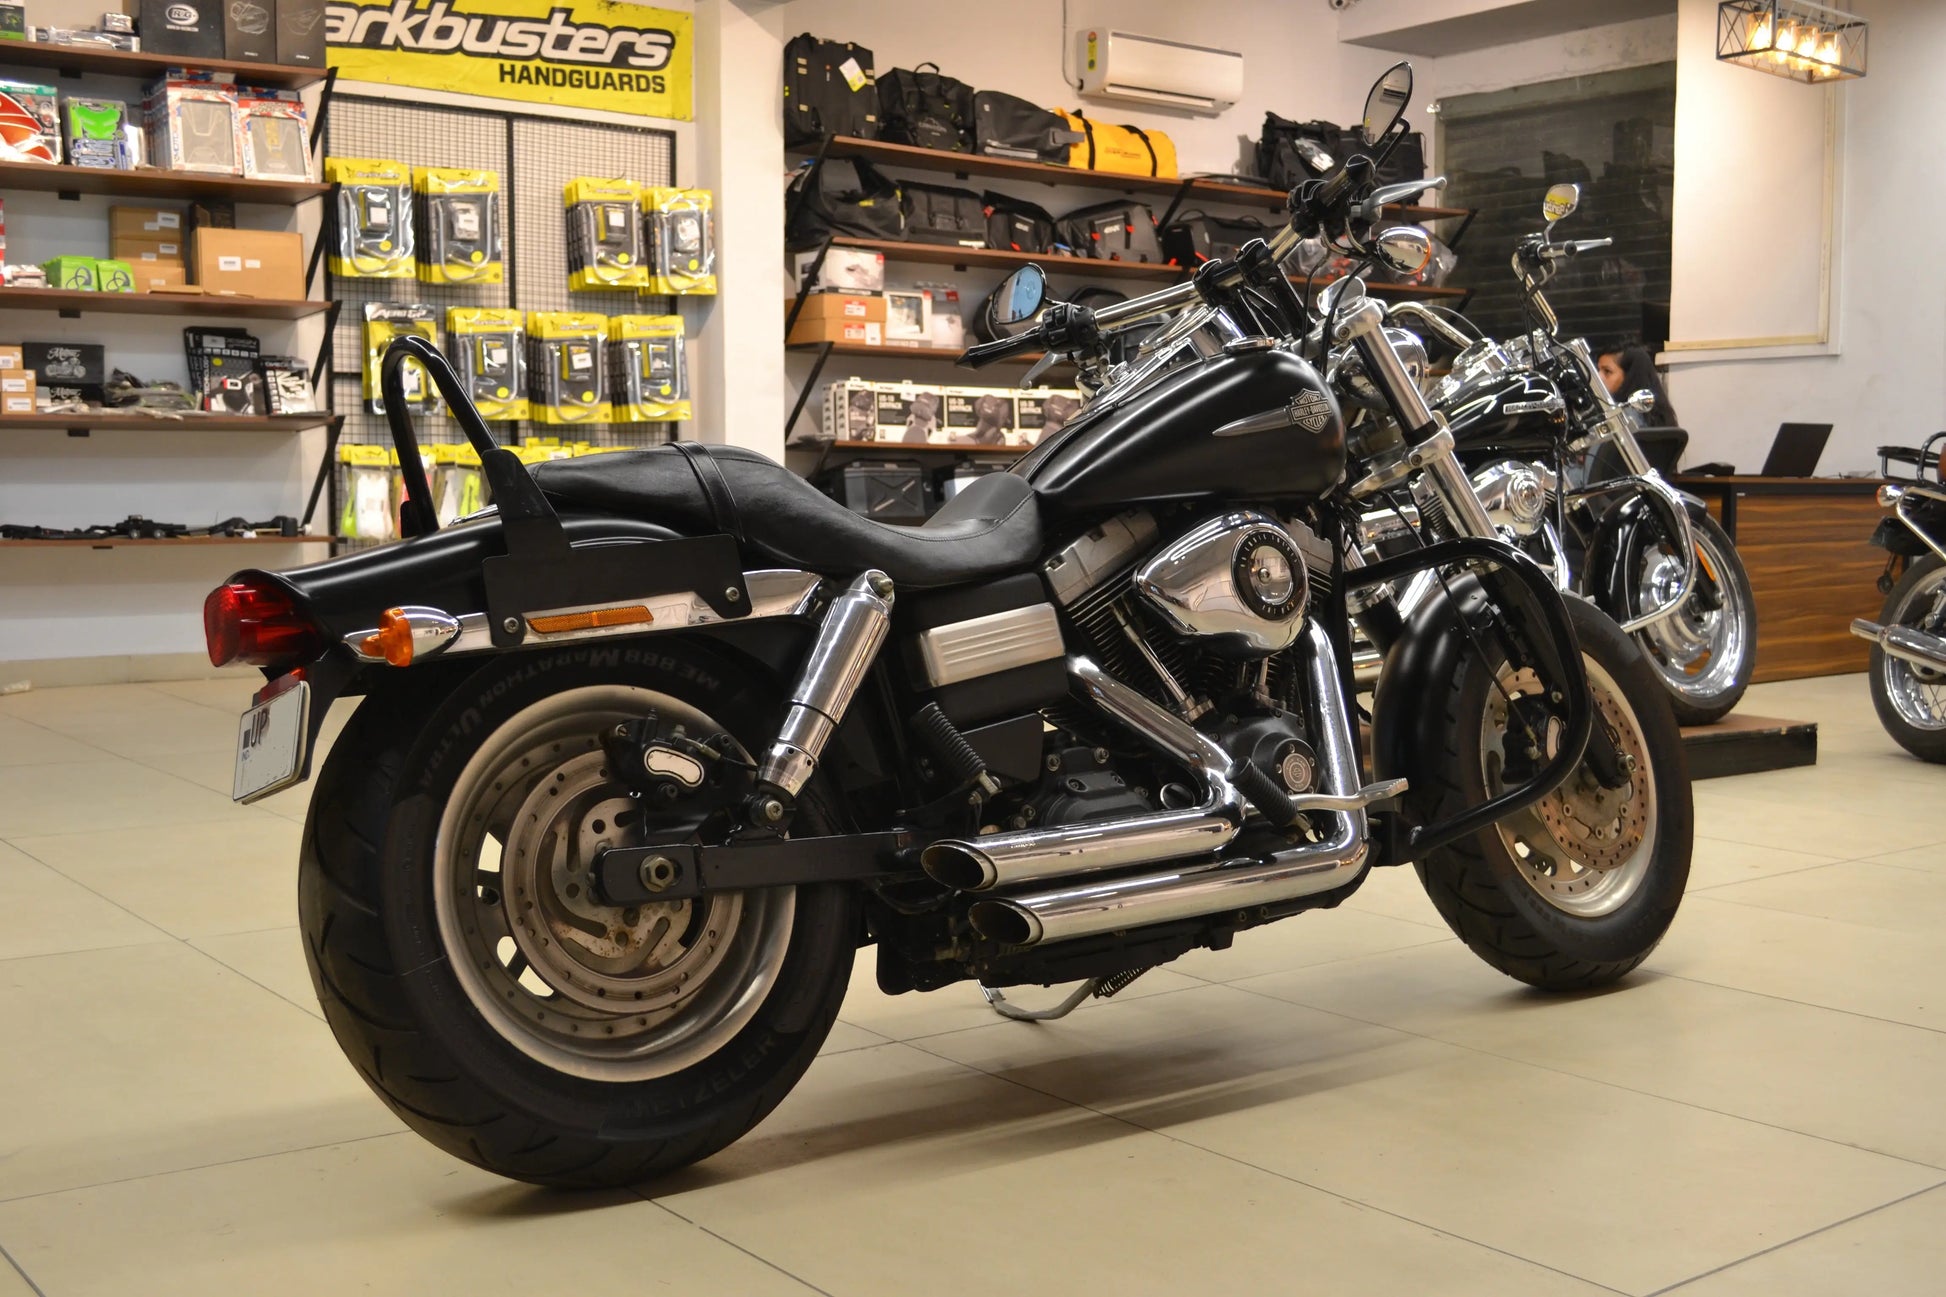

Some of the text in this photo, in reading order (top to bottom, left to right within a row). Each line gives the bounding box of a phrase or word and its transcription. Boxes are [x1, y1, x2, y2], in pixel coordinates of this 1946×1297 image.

[325, 0, 672, 66] arkbusters
[499, 63, 666, 94] HANDGUARDS
[1294, 403, 1329, 418] HARLEY-DAVIDSON
[1306, 415, 1326, 427] CYCLES
[622, 647, 675, 672] 888
[479, 648, 619, 706] MARATHON
[683, 664, 721, 690] ME
[251, 708, 269, 747] UP
